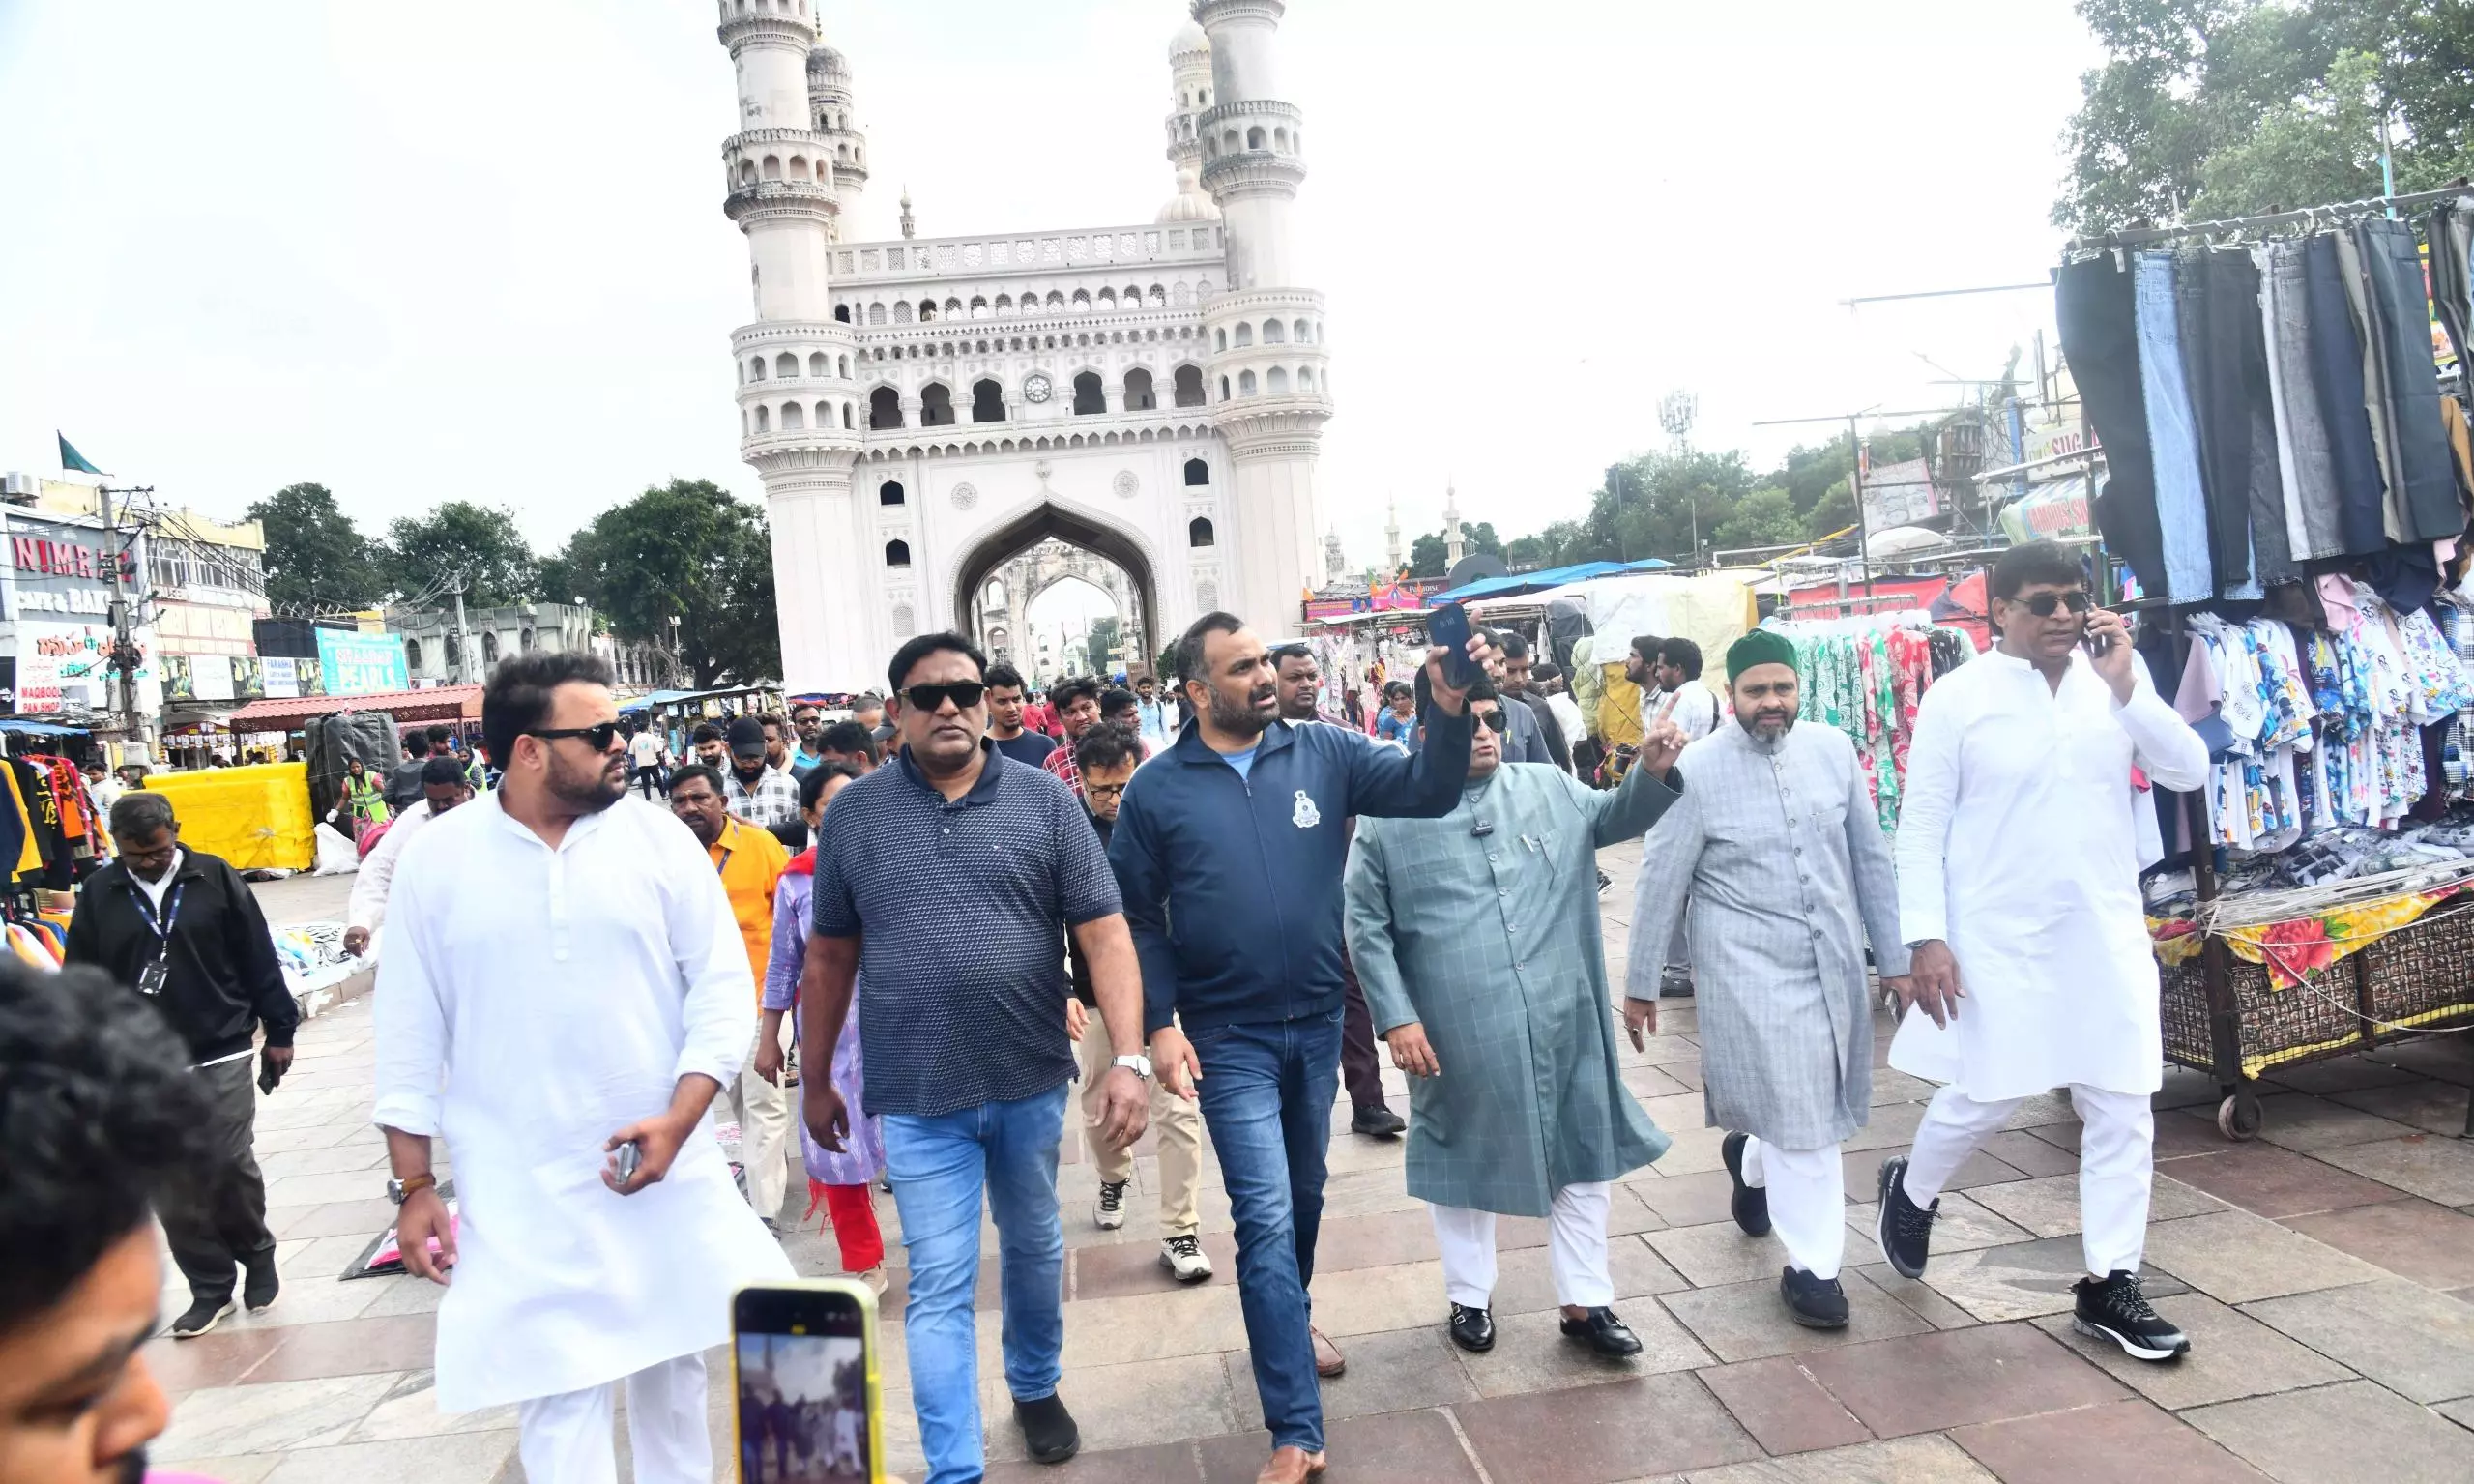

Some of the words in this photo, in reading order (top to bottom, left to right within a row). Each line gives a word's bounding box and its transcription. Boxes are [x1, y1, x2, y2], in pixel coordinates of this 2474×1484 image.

[21, 686, 62, 699] MAQBOOL
[23, 702, 38, 713] PAN
[41, 702, 60, 713] SHOP
